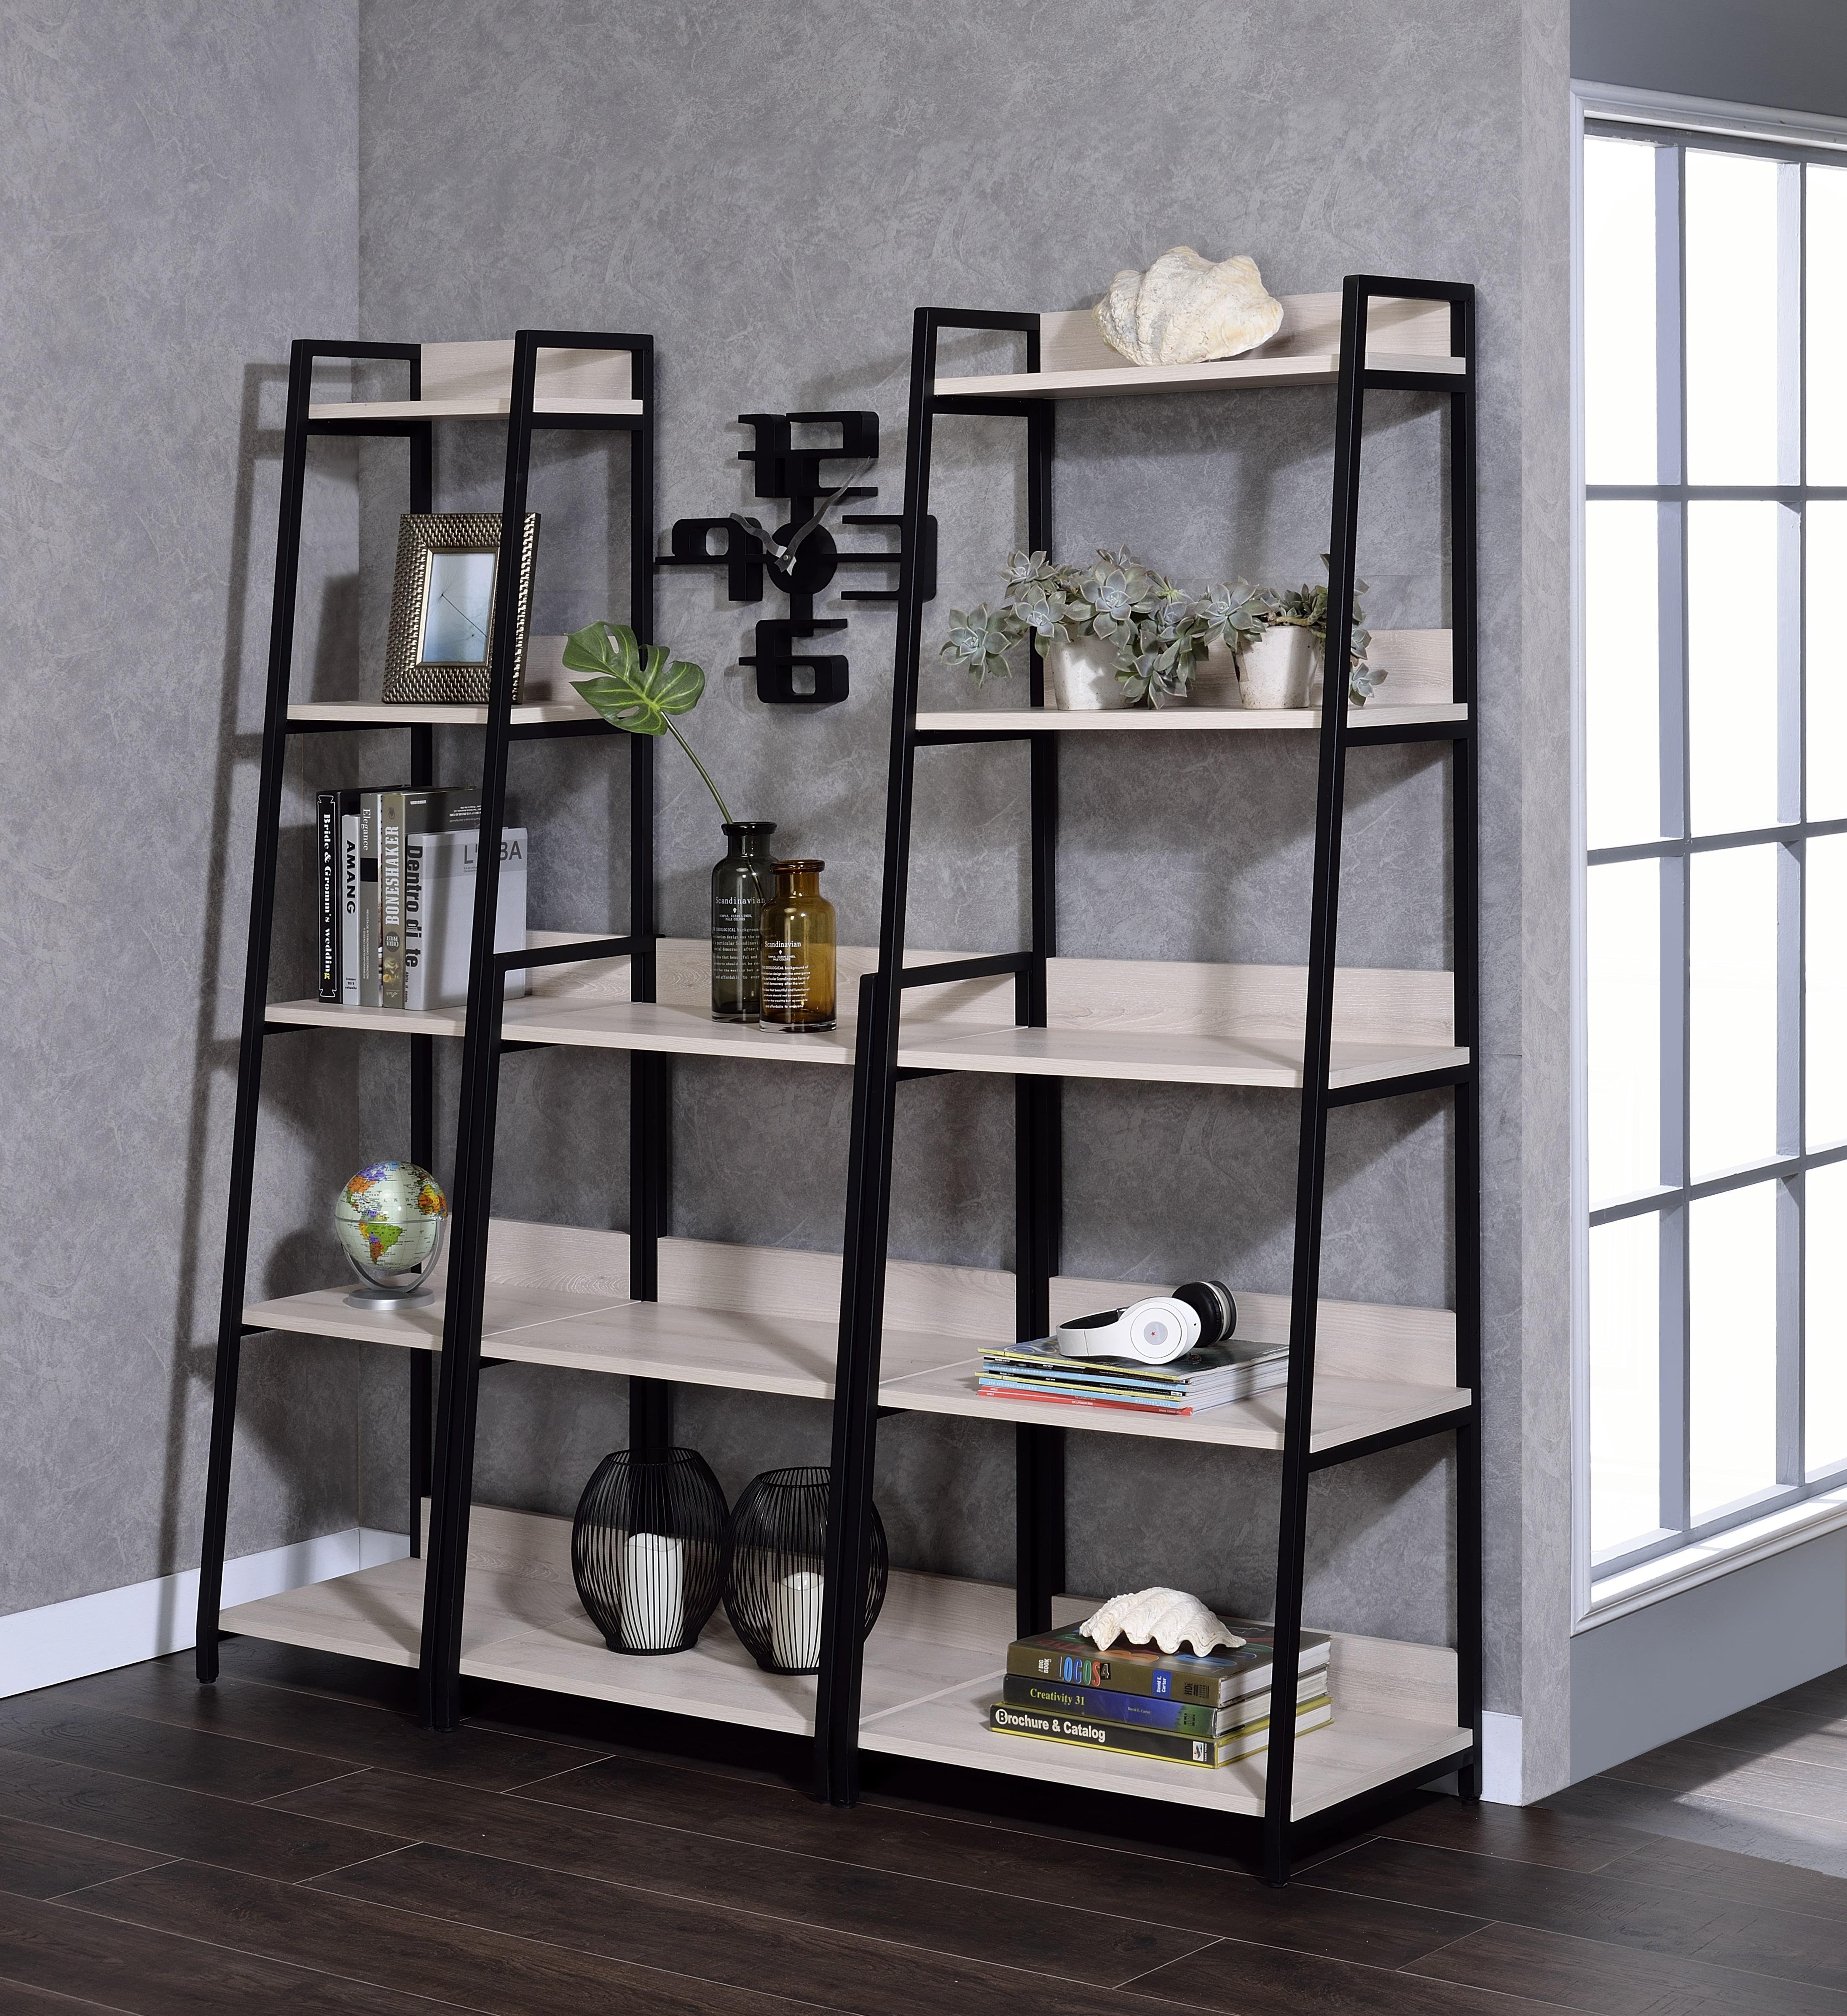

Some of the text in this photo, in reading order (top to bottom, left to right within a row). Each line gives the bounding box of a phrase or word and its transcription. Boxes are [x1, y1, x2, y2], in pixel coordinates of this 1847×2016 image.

[361, 809, 371, 850] Elegance
[324, 852, 331, 863] &
[346, 840, 356, 914] AMANG
[385, 826, 399, 925] BONESHAKER
[406, 845, 423, 967] Dentro di te
[324, 928, 332, 980] wedding
[1058, 1656, 1101, 1686] LOGOS
[1030, 1688, 1085, 1706] Creativity 31
[995, 1709, 1106, 1743] Brochure & Catalog
